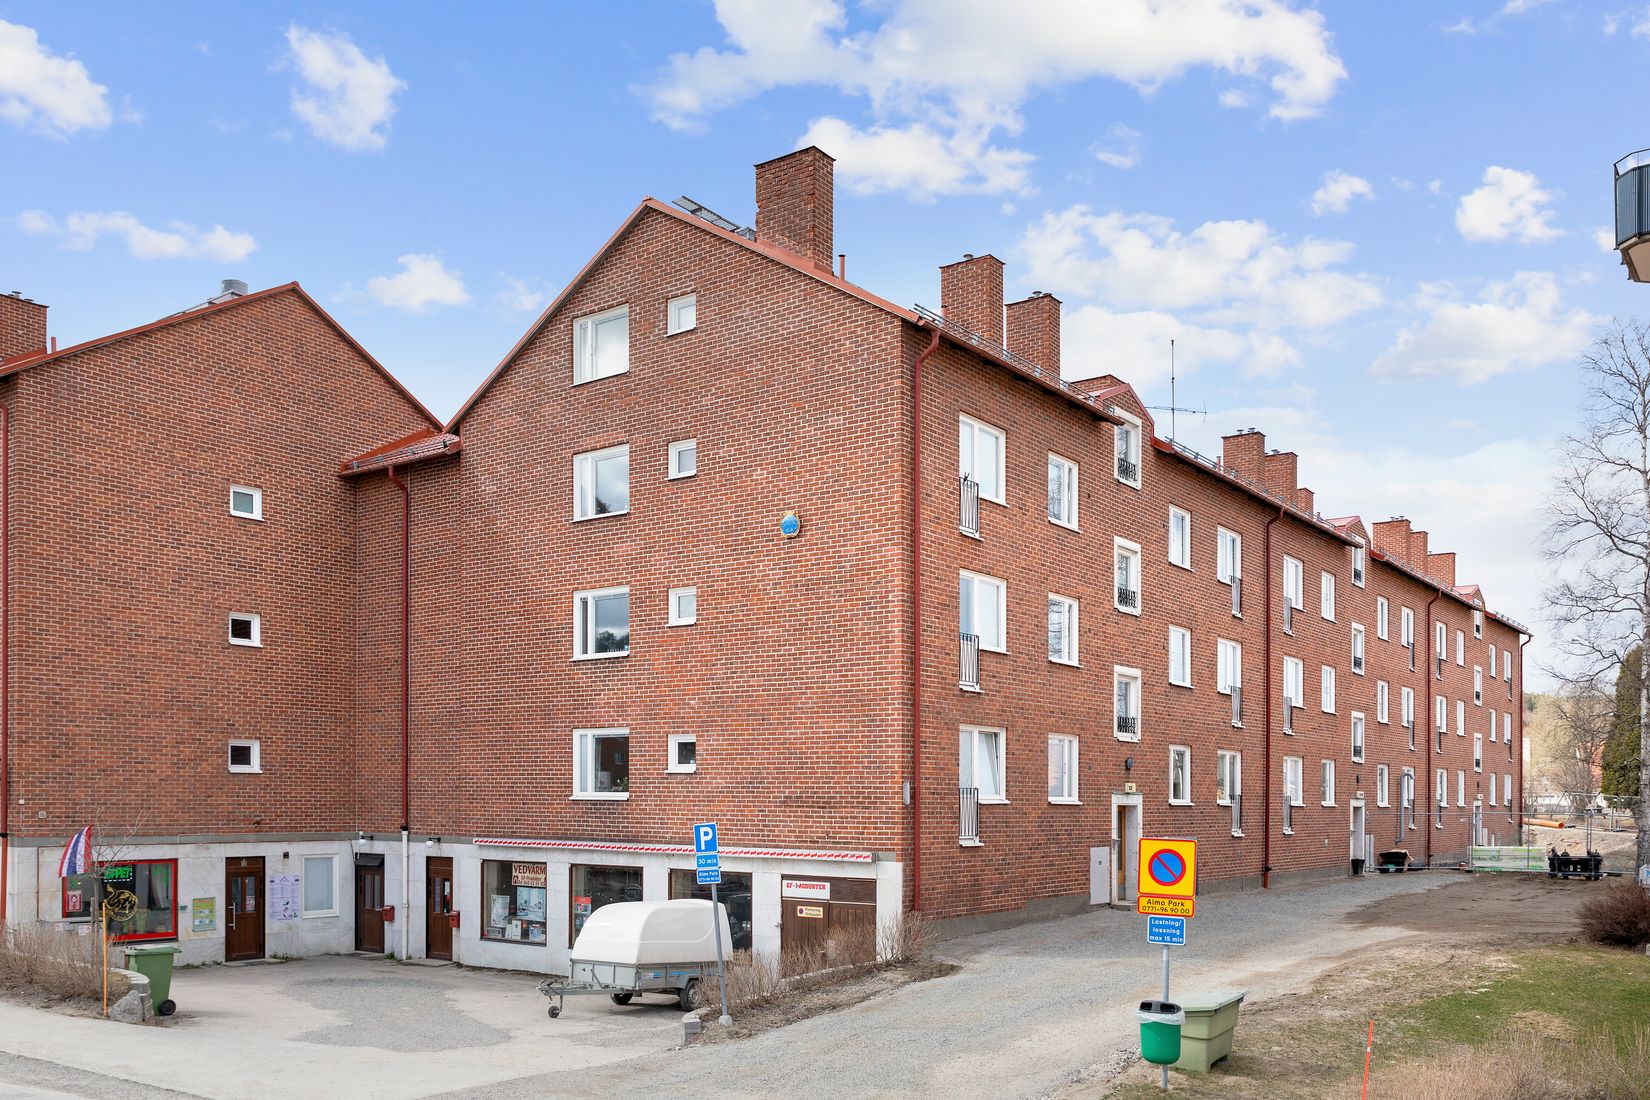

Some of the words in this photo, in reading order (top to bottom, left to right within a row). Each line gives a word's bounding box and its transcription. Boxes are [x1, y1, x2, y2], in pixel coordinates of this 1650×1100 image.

[699, 826, 713, 850] P
[513, 863, 546, 875] VEDVÄRM
[1146, 898, 1165, 906] Aimo
[1151, 919, 1182, 927] Lastning/
[1152, 927, 1180, 935] lossning
